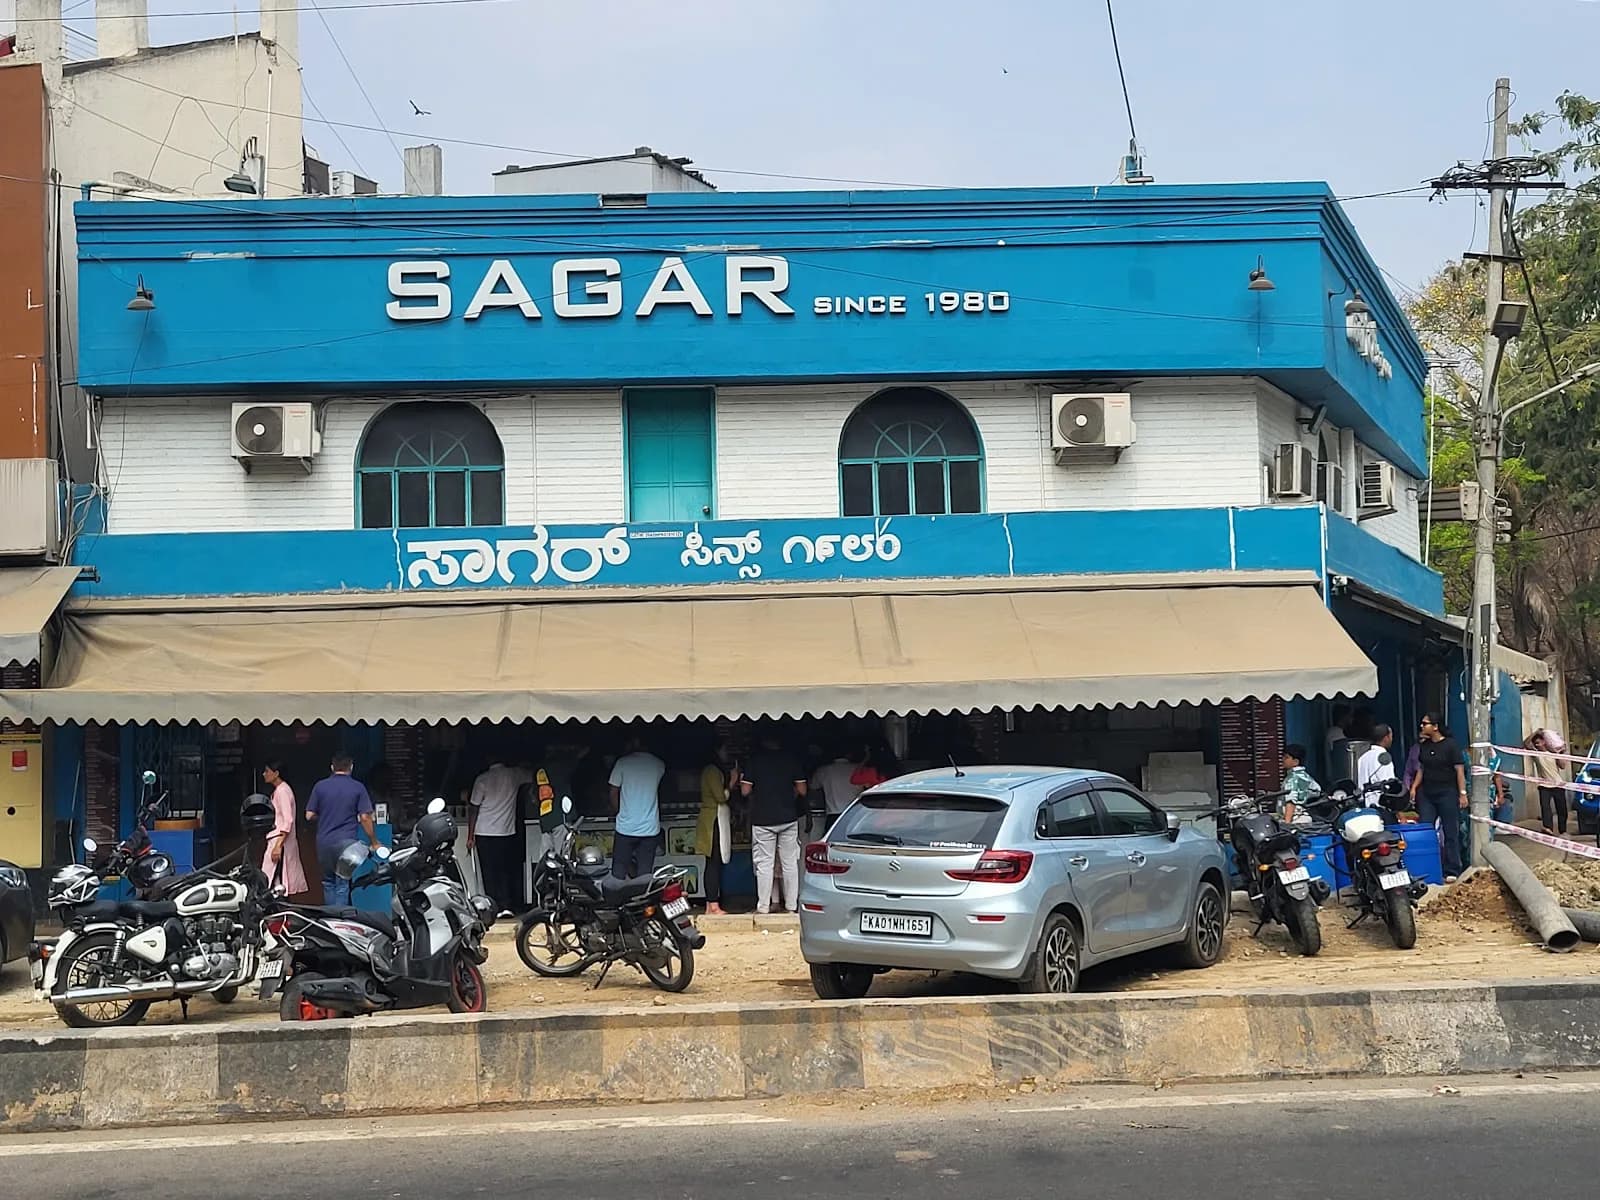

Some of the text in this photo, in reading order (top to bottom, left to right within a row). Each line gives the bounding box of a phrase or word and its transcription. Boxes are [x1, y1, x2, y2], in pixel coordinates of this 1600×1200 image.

[386, 256, 1010, 320] SAGAR SINCE 1980
